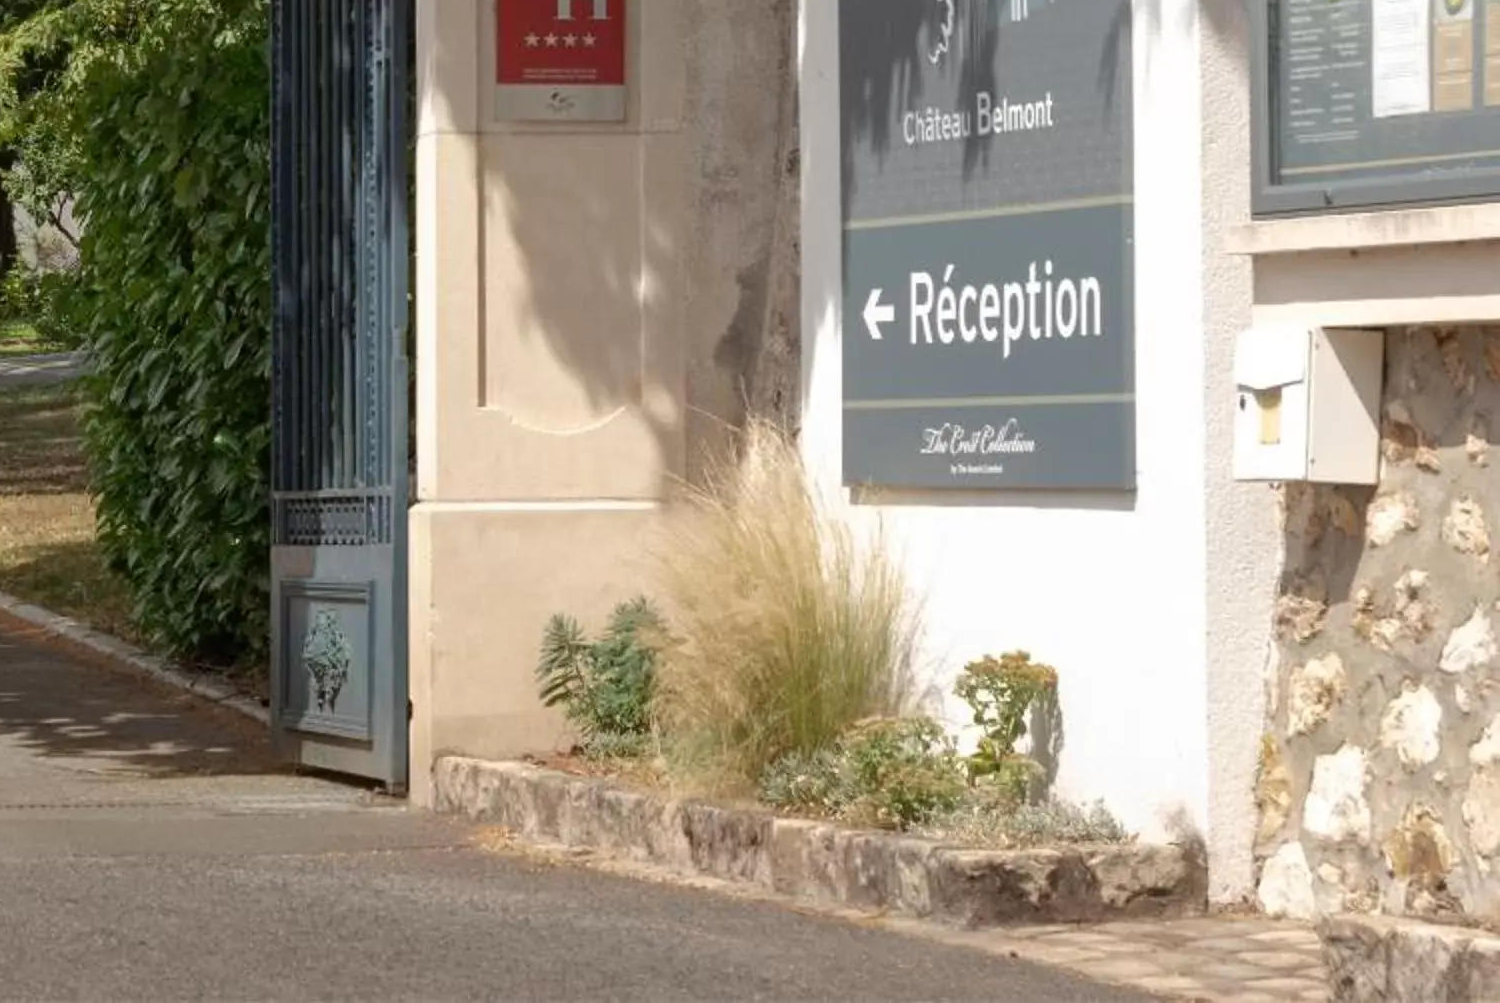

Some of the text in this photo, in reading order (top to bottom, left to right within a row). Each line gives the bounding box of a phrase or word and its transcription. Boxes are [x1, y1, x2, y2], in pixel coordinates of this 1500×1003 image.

[903, 90, 1054, 145] Château Belmont
[909, 260, 1102, 359] Réception
[920, 422, 949, 454] The
[980, 417, 1035, 454] Collection
